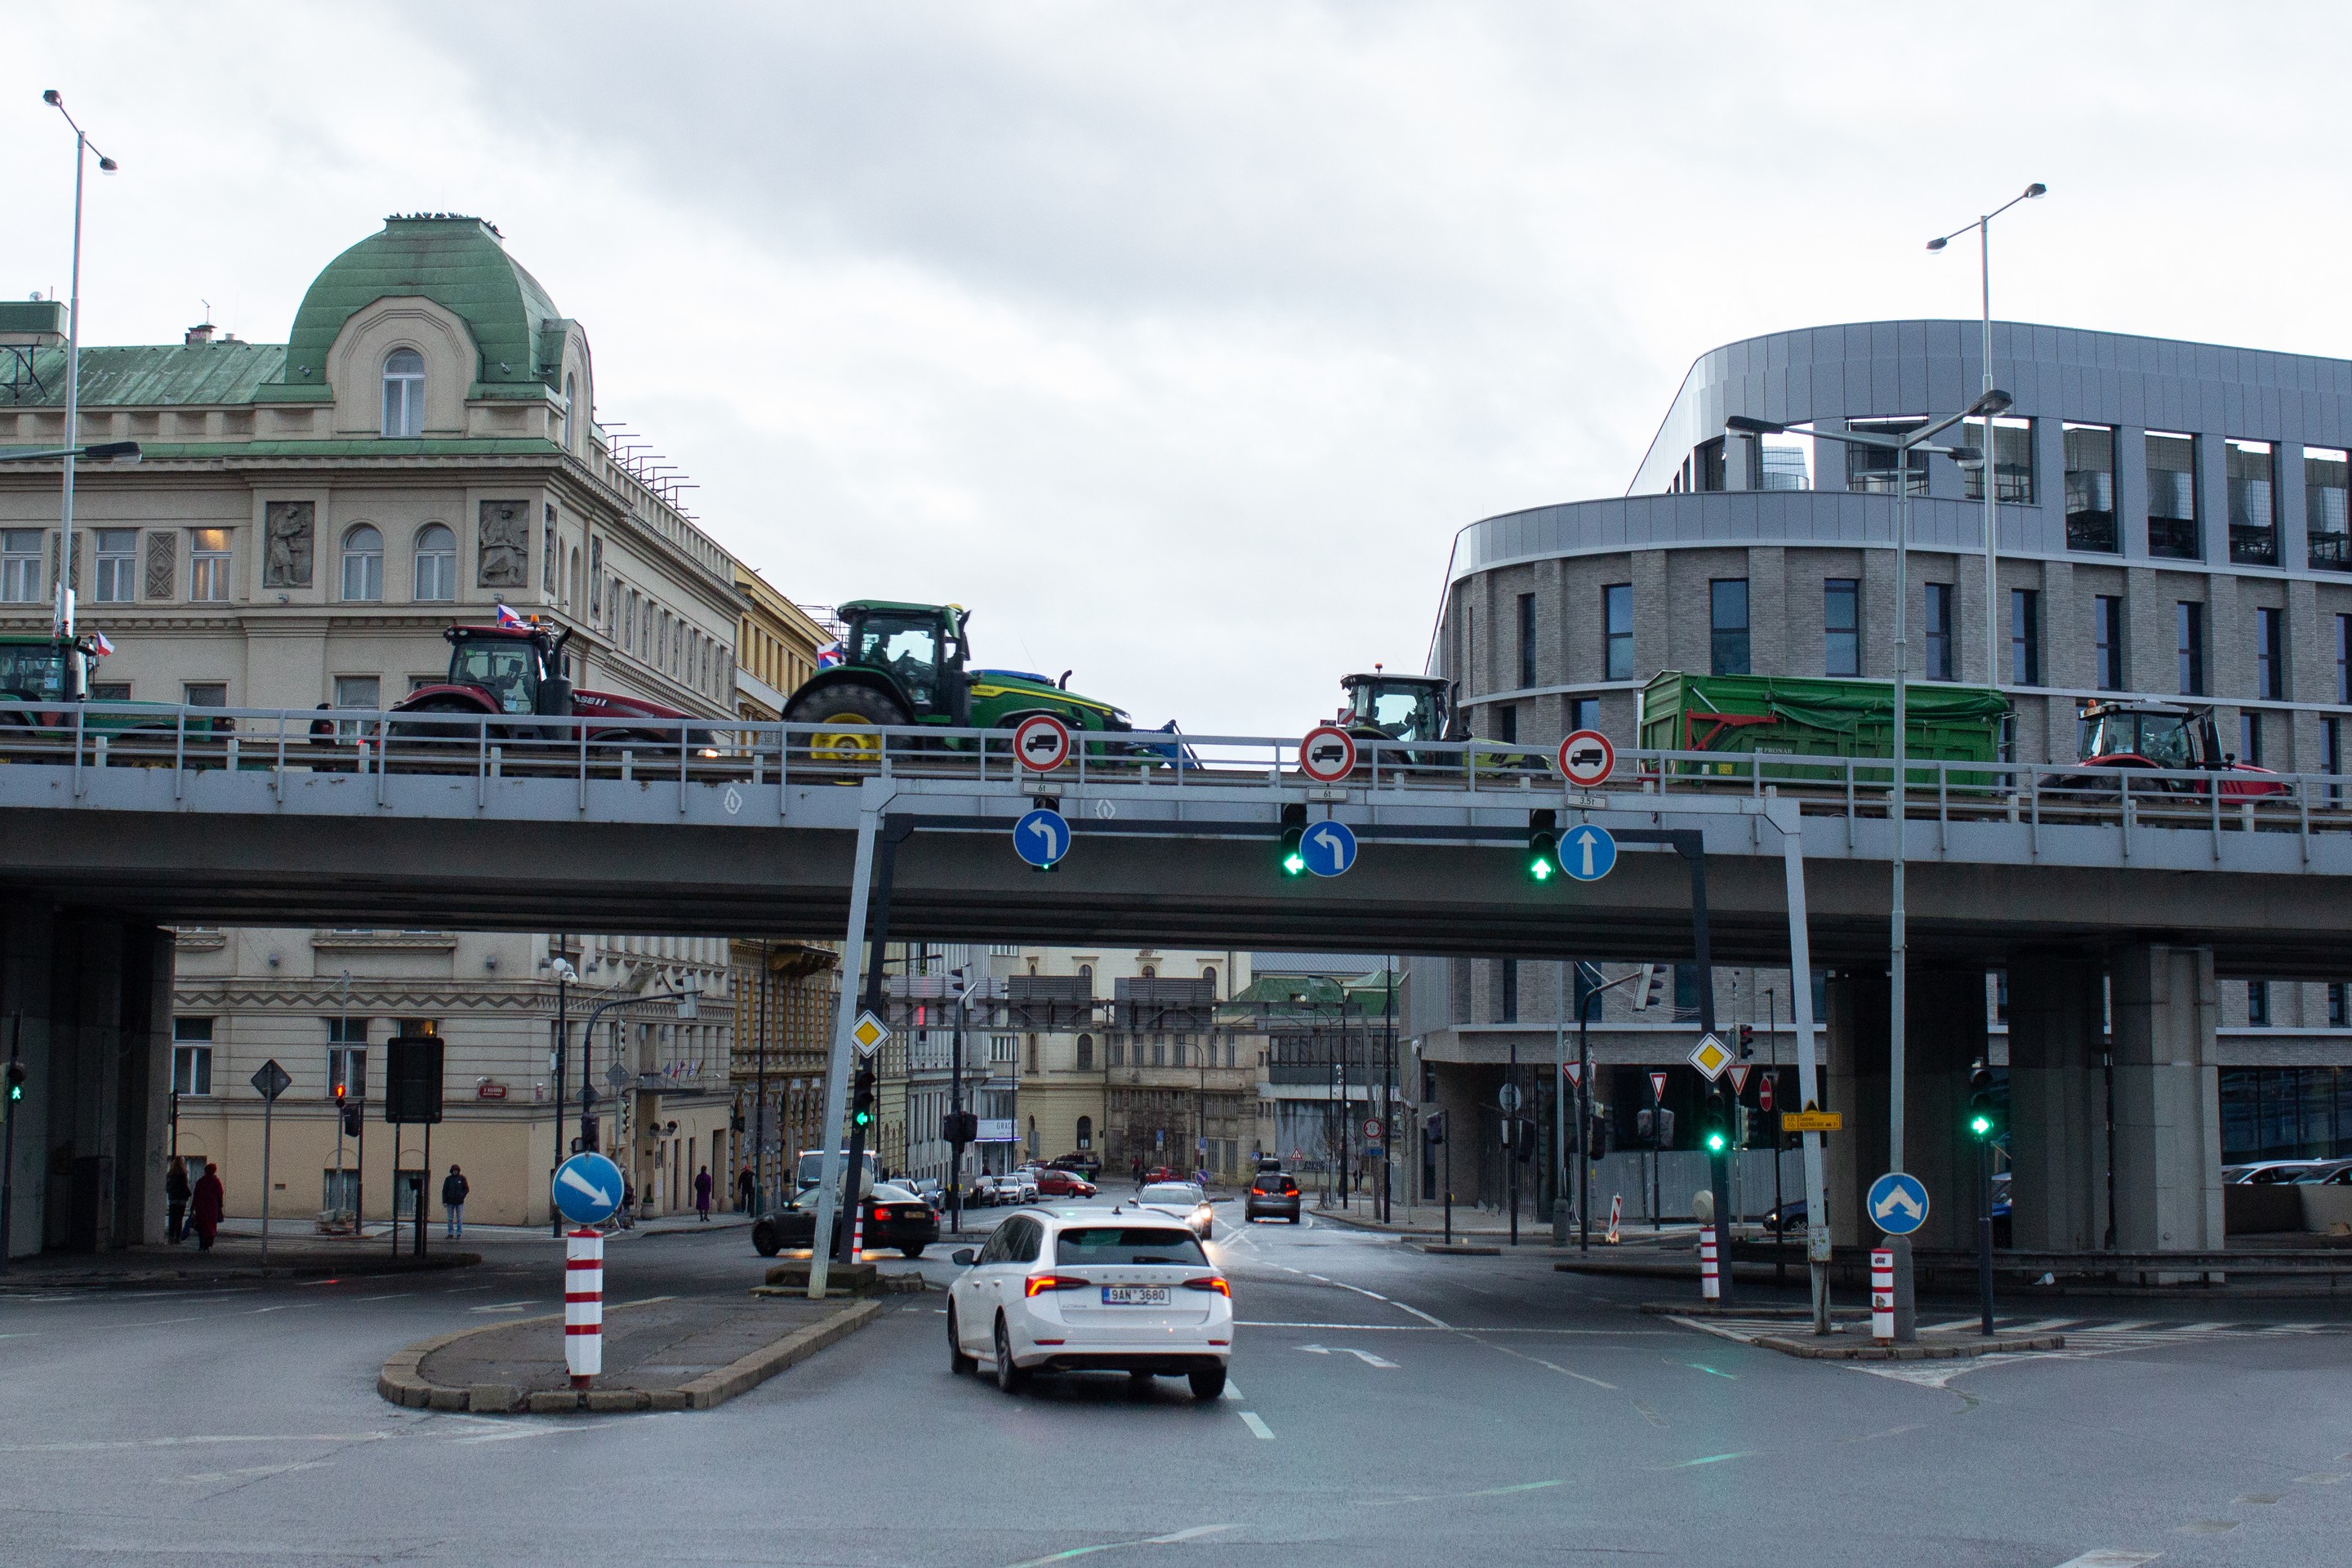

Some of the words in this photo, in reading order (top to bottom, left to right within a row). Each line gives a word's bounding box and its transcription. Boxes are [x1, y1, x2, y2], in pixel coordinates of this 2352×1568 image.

[1764, 746, 1793, 755] PRONAR
[1111, 1290, 1132, 1300] 9AN
[1139, 1290, 1165, 1301] 3680
